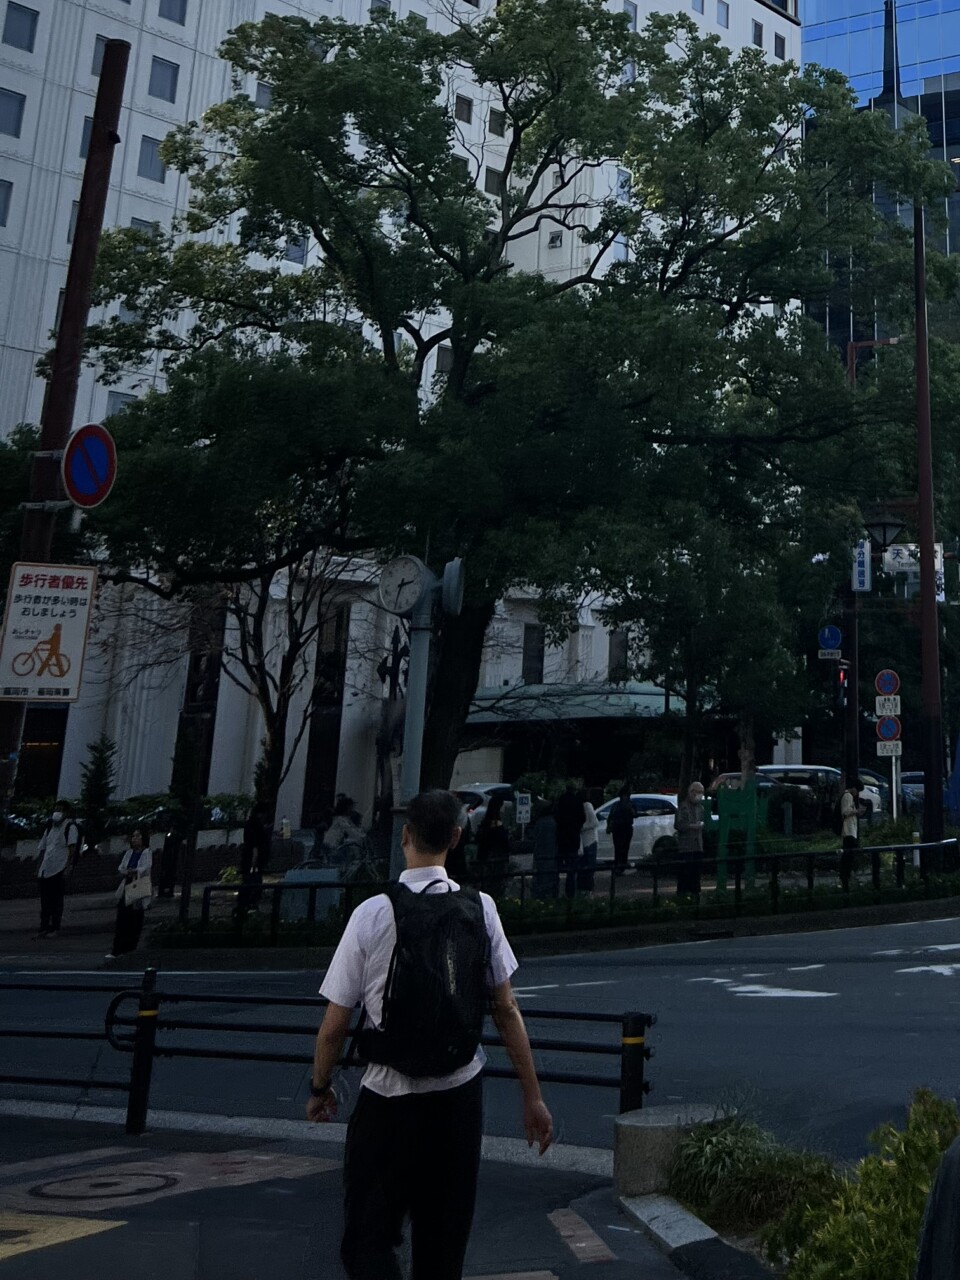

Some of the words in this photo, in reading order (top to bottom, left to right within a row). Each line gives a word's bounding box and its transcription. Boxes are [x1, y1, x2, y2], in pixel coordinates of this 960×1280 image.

[19, 573, 88, 590] 歩行者優先
[13, 594, 88, 607] 歩行者が多い時は
[21, 607, 77, 618] おしましょう
